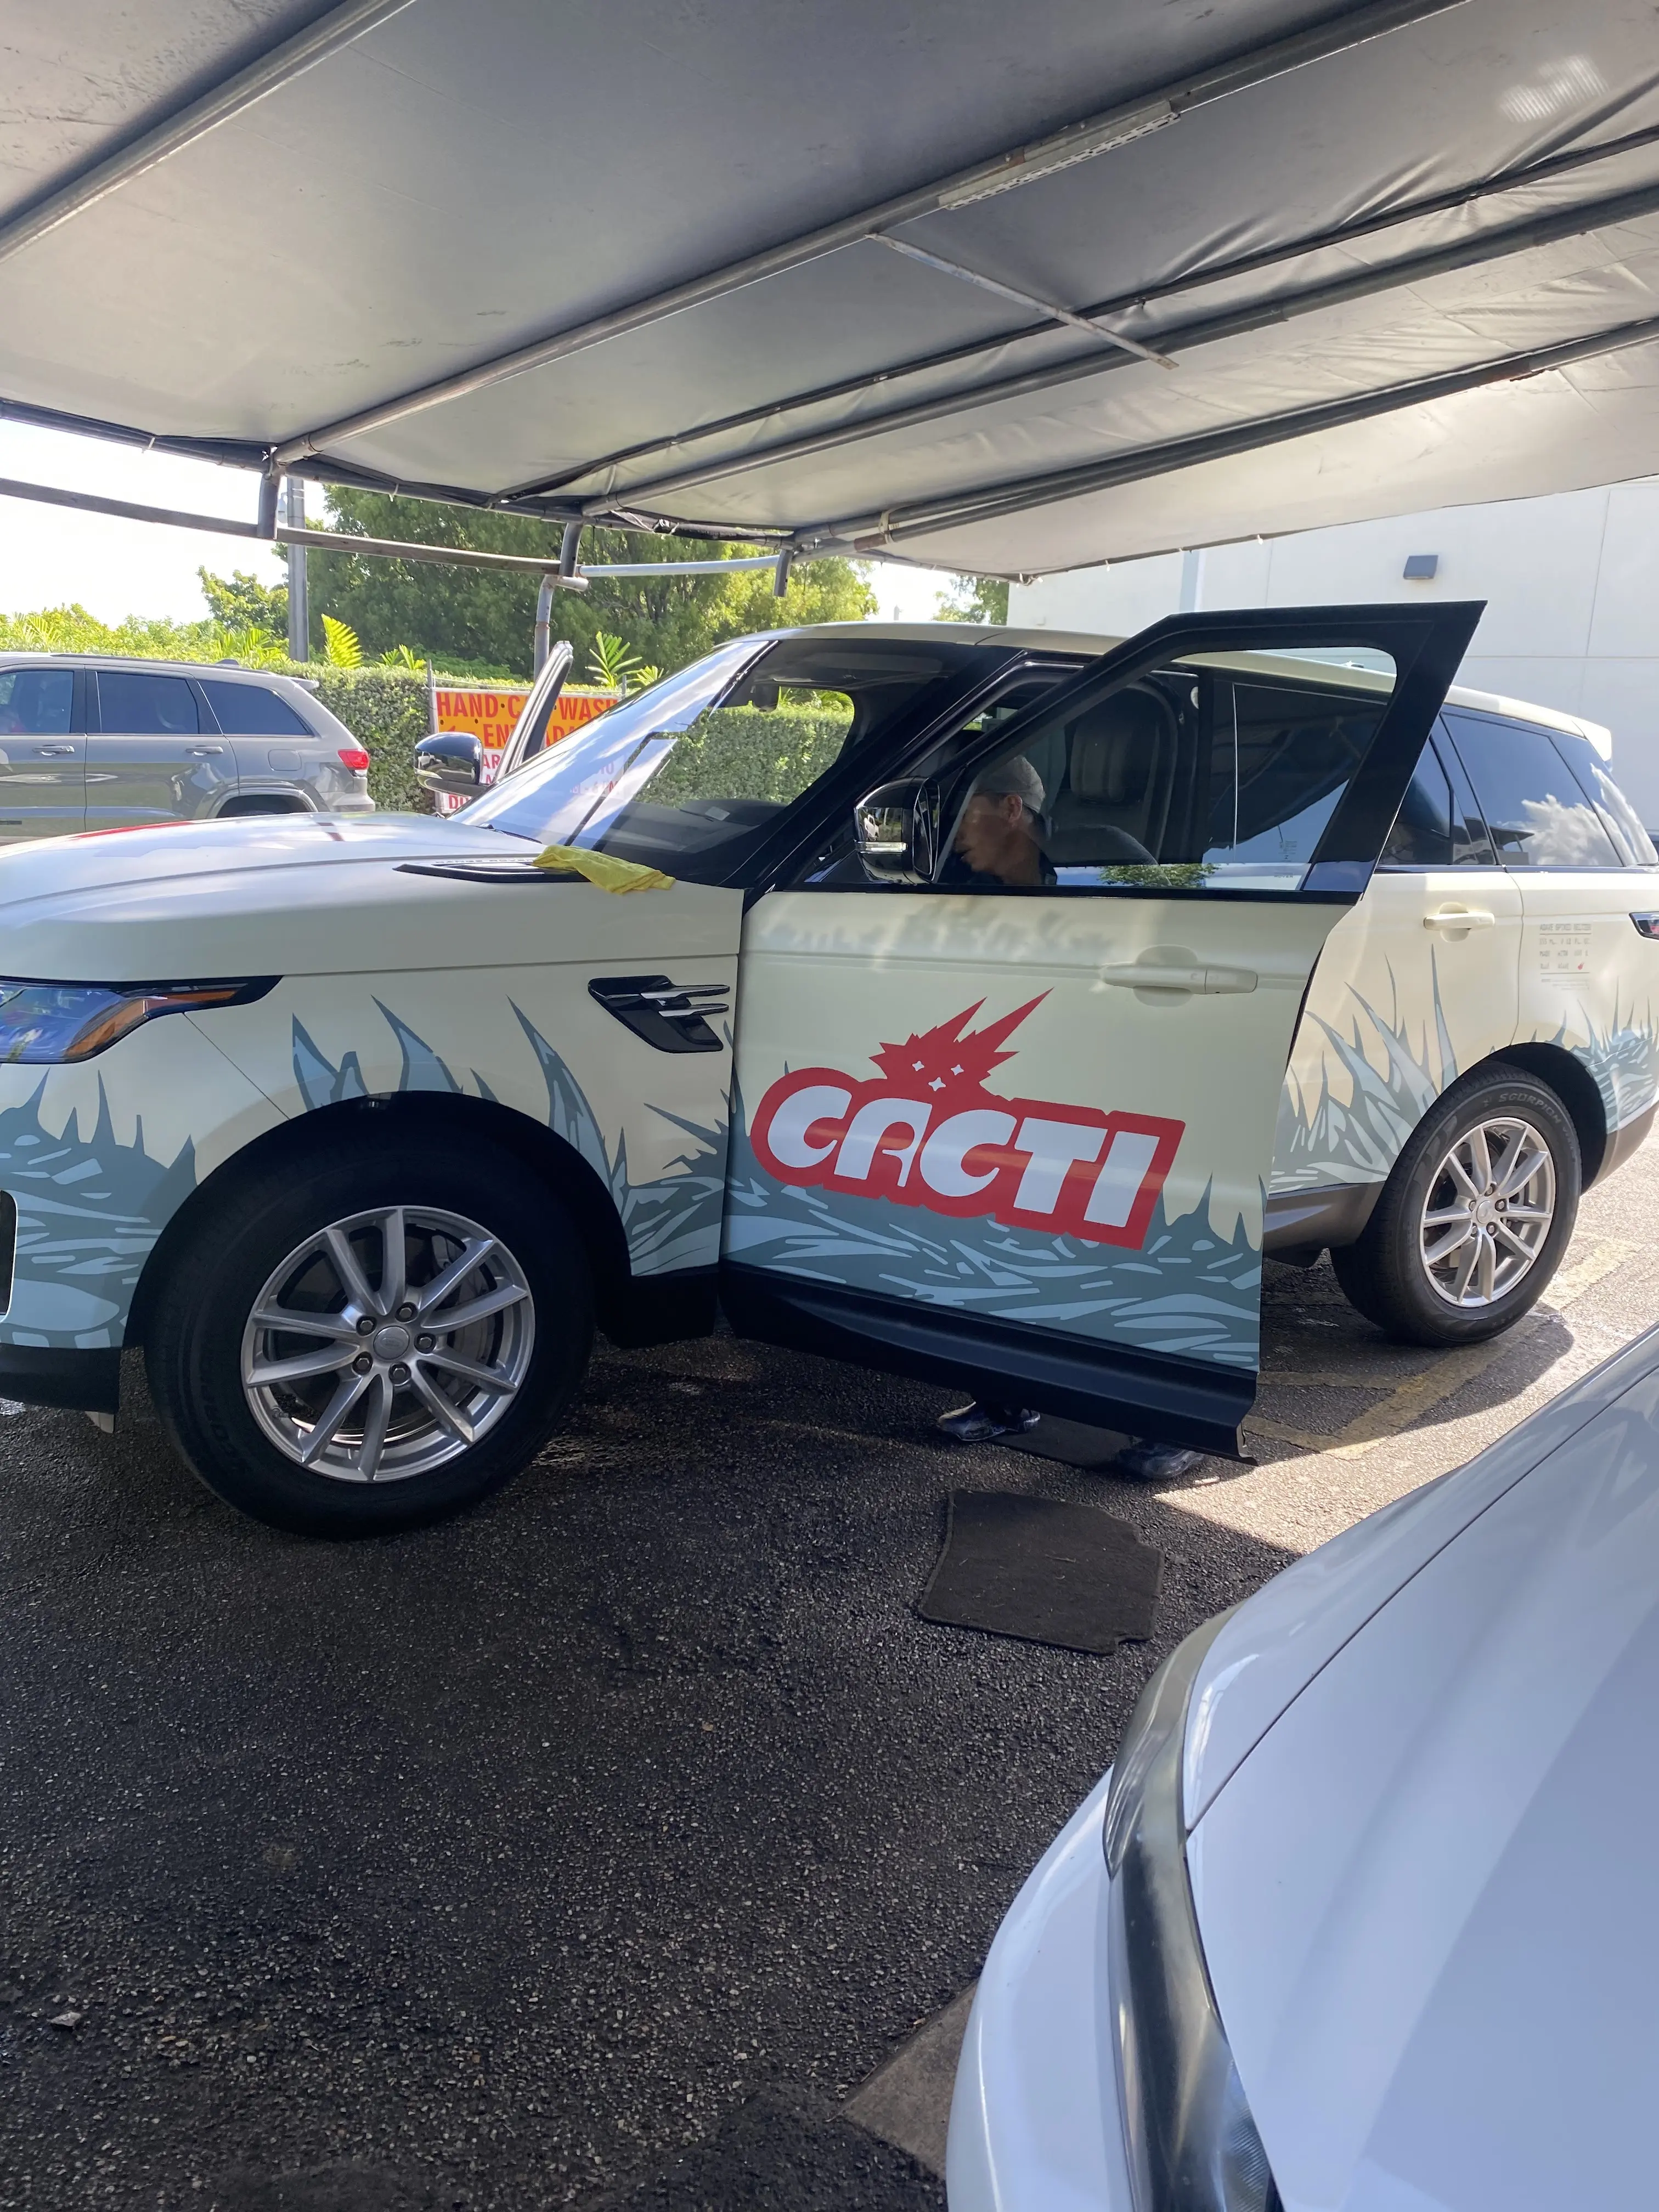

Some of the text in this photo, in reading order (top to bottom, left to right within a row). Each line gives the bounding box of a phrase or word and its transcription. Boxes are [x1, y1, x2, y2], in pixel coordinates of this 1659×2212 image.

[436, 692, 499, 718] HAND
[558, 697, 618, 720] WAS
[1498, 1092, 1562, 1124] SCORPION
[767, 1084, 1161, 1228] CACTI
